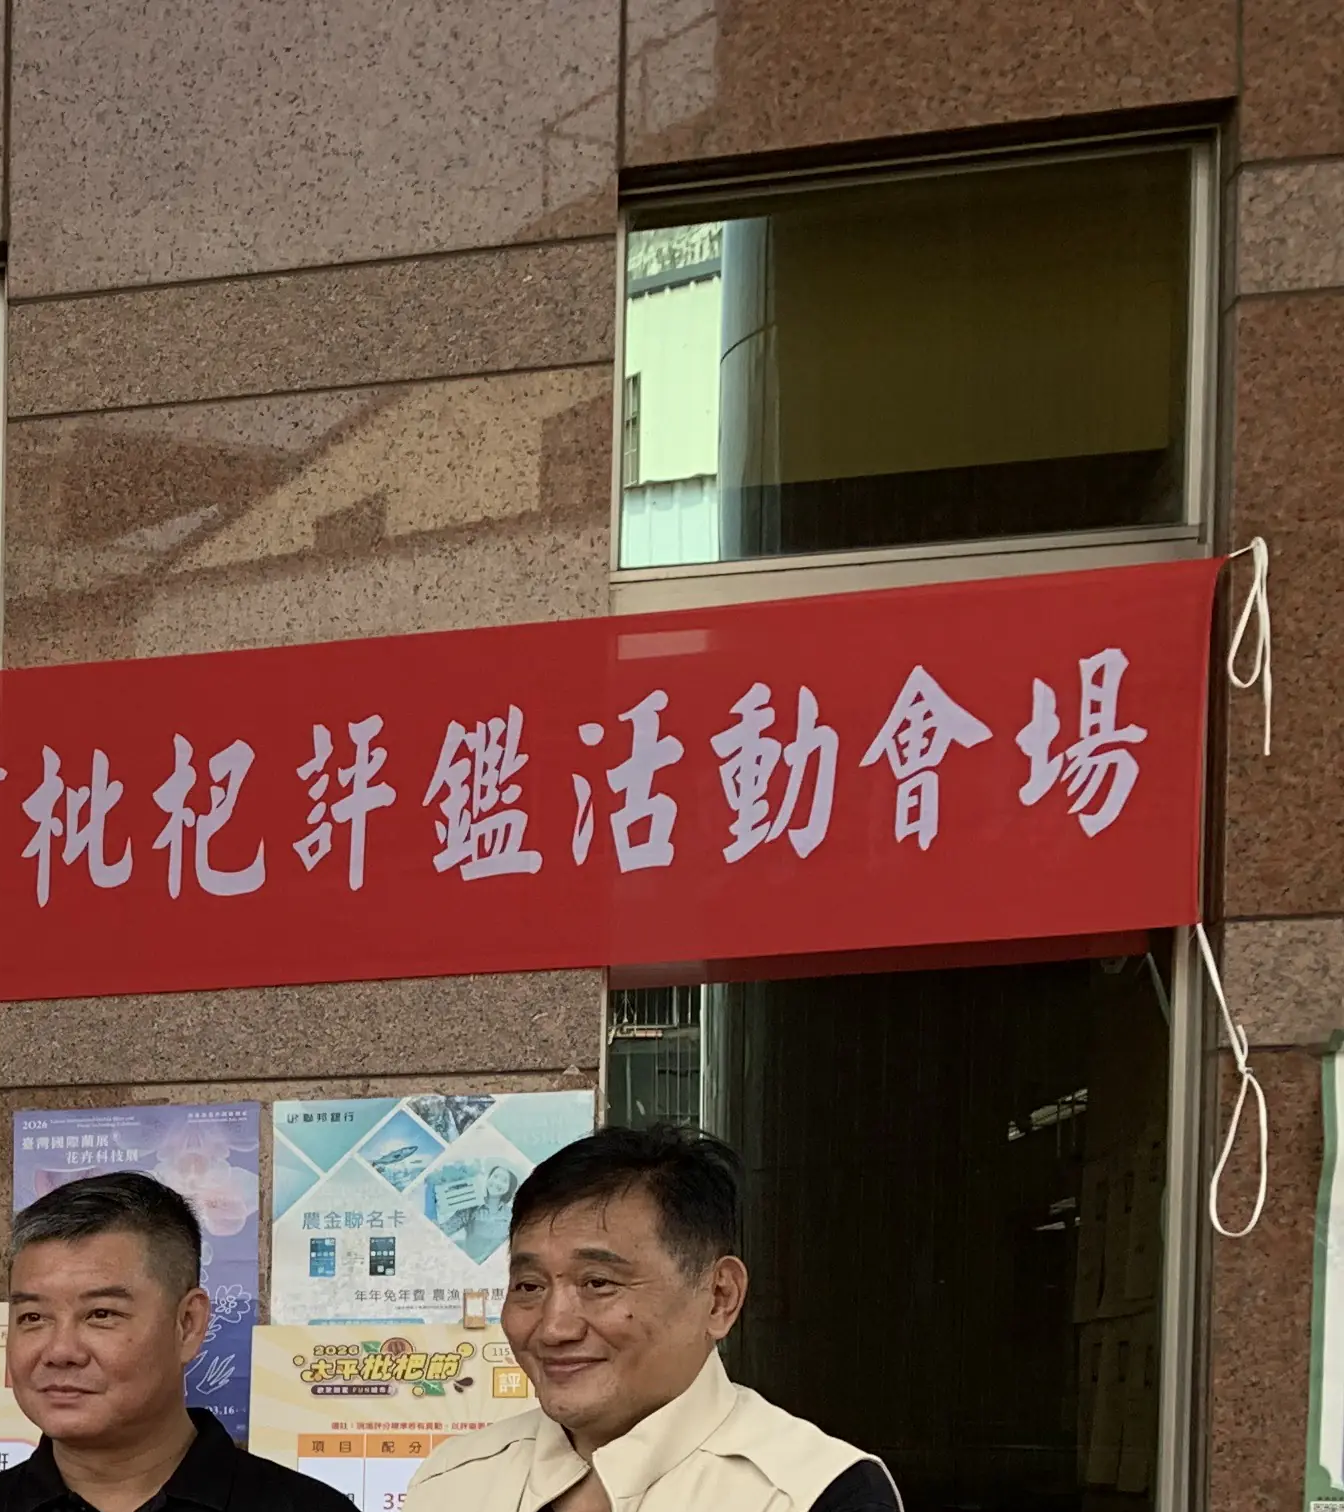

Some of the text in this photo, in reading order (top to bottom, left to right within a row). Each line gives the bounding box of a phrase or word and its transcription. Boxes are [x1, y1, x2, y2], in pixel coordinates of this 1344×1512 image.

[302, 1211, 406, 1230] 農金聯名卡
[354, 1289, 425, 1302] 年年免年費
[308, 1352, 463, 1382] 太平枇杷節
[381, 1441, 422, 1453] 配分
